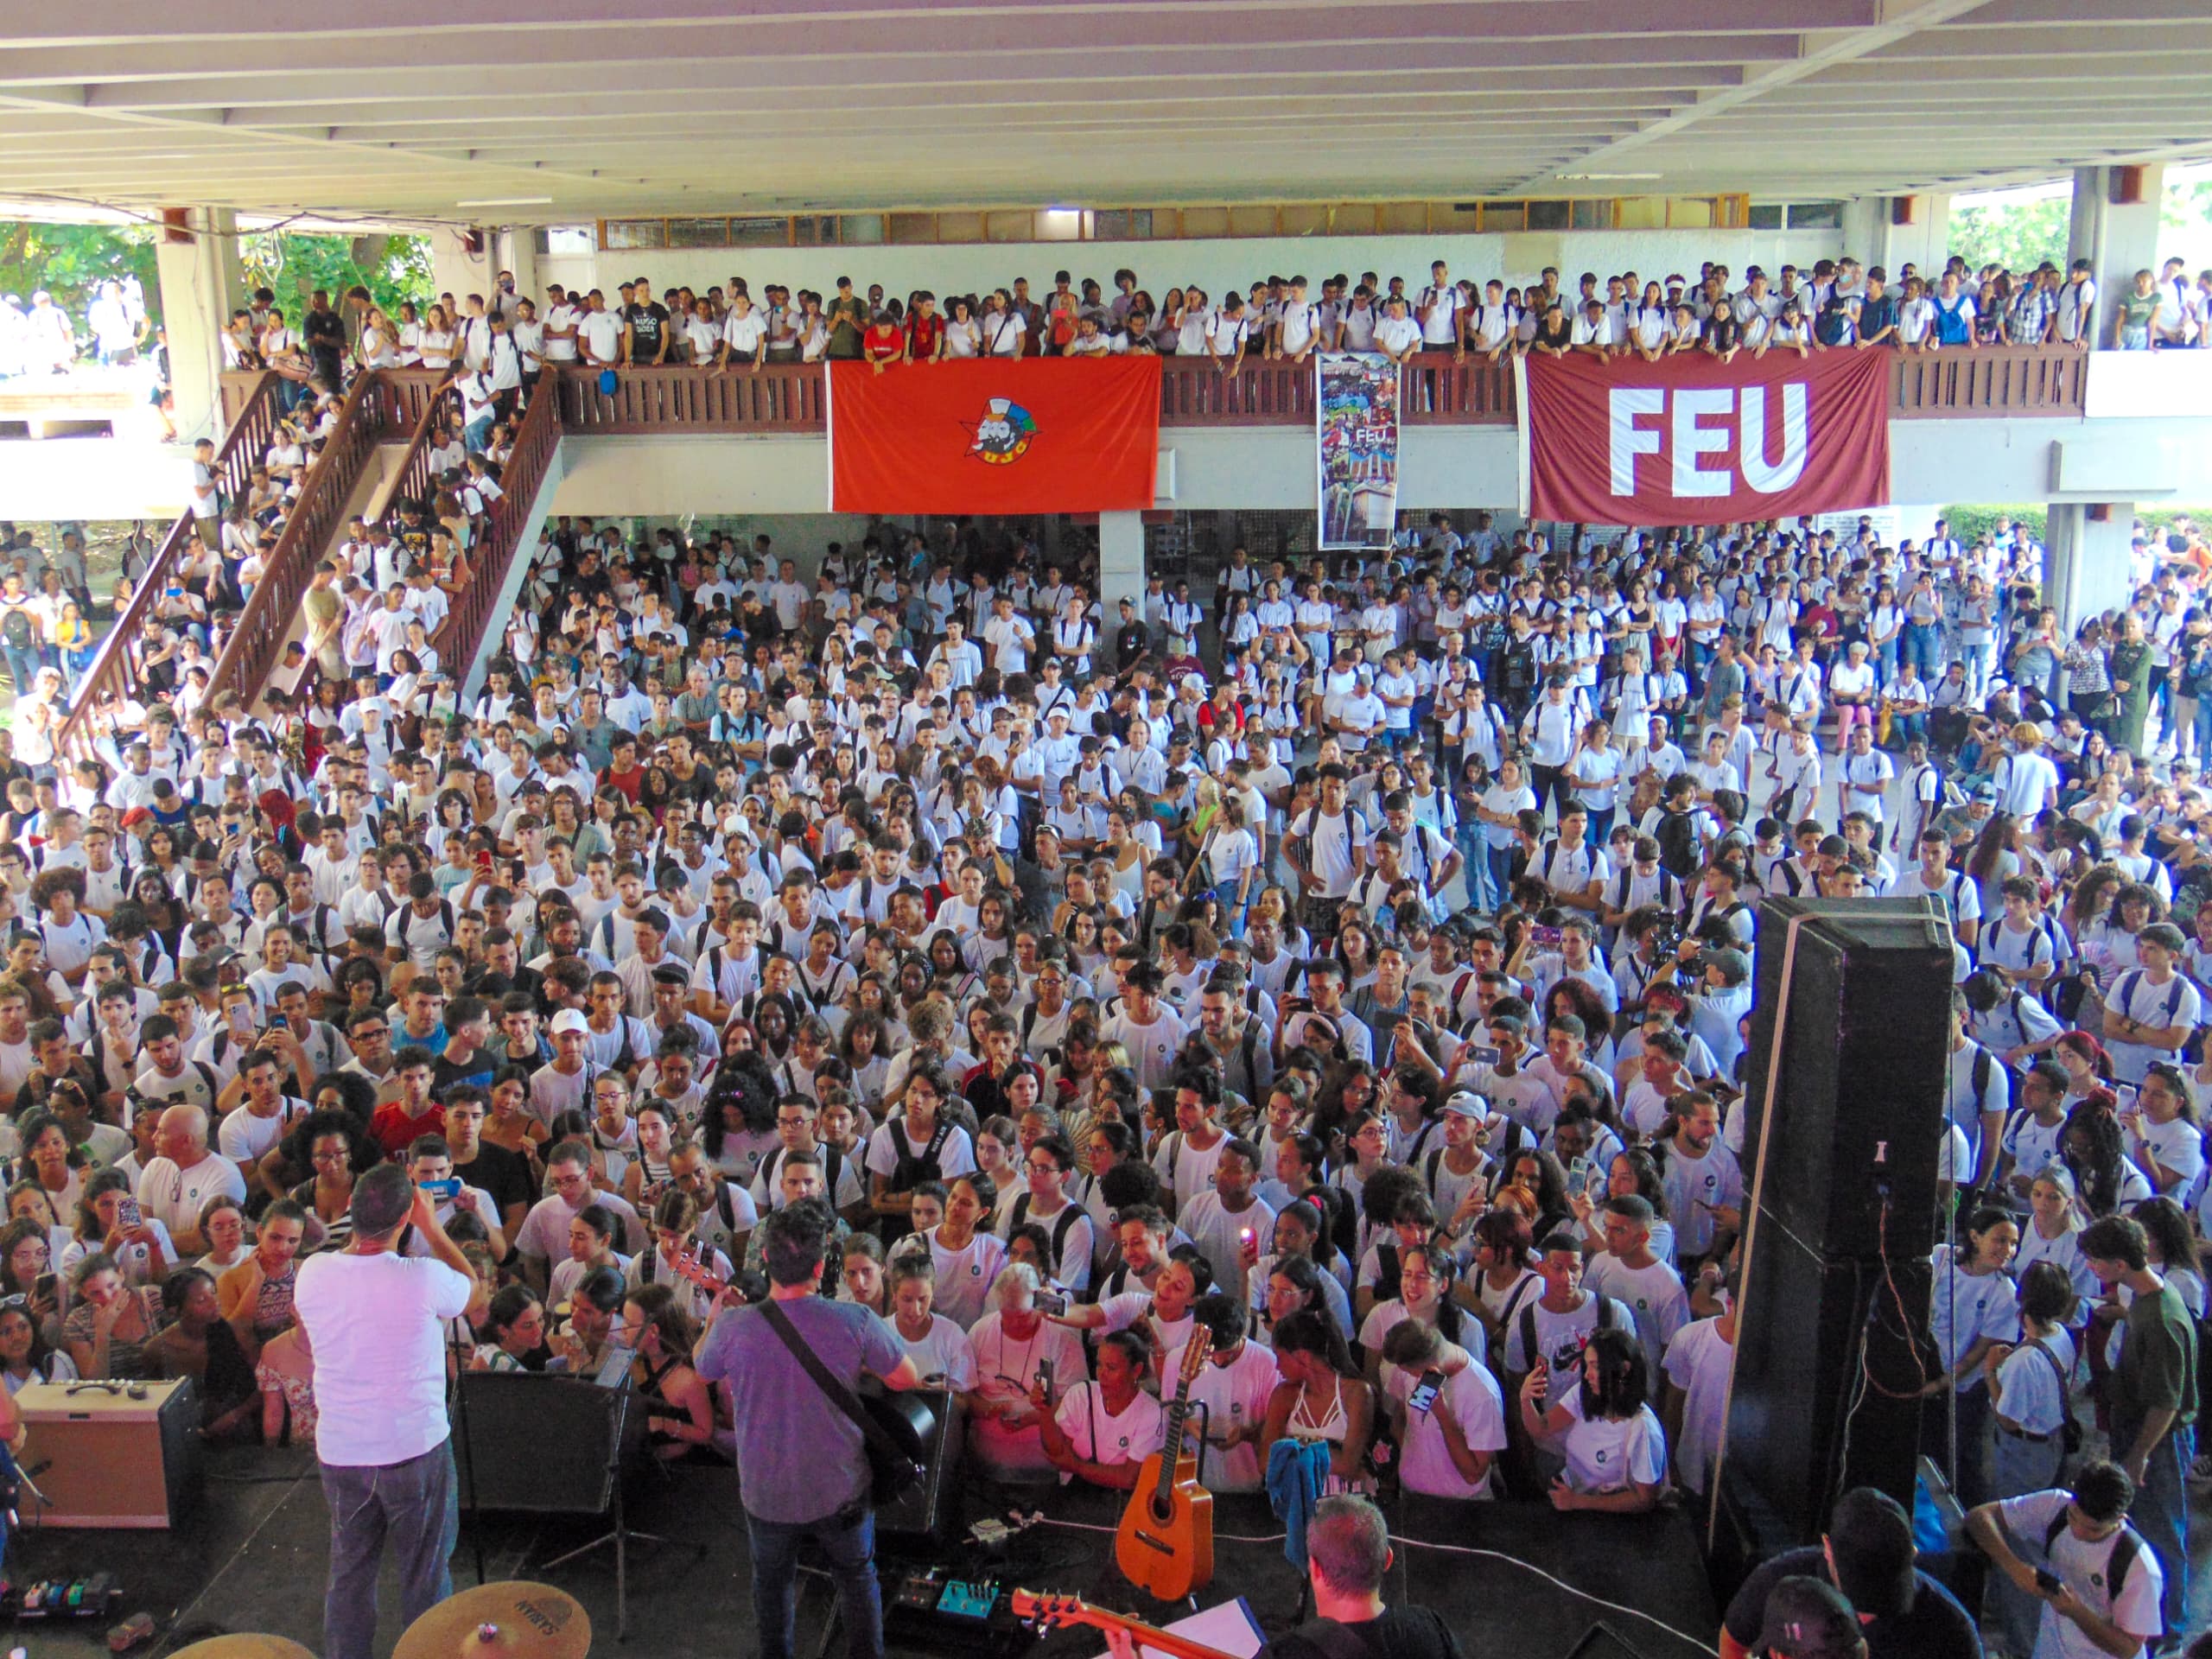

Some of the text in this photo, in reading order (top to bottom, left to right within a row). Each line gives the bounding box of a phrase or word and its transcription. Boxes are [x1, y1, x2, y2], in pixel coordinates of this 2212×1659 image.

[1356, 429, 1386, 442] FEU
[1609, 383, 1807, 498] FEU
[984, 440, 1027, 464] UJC
